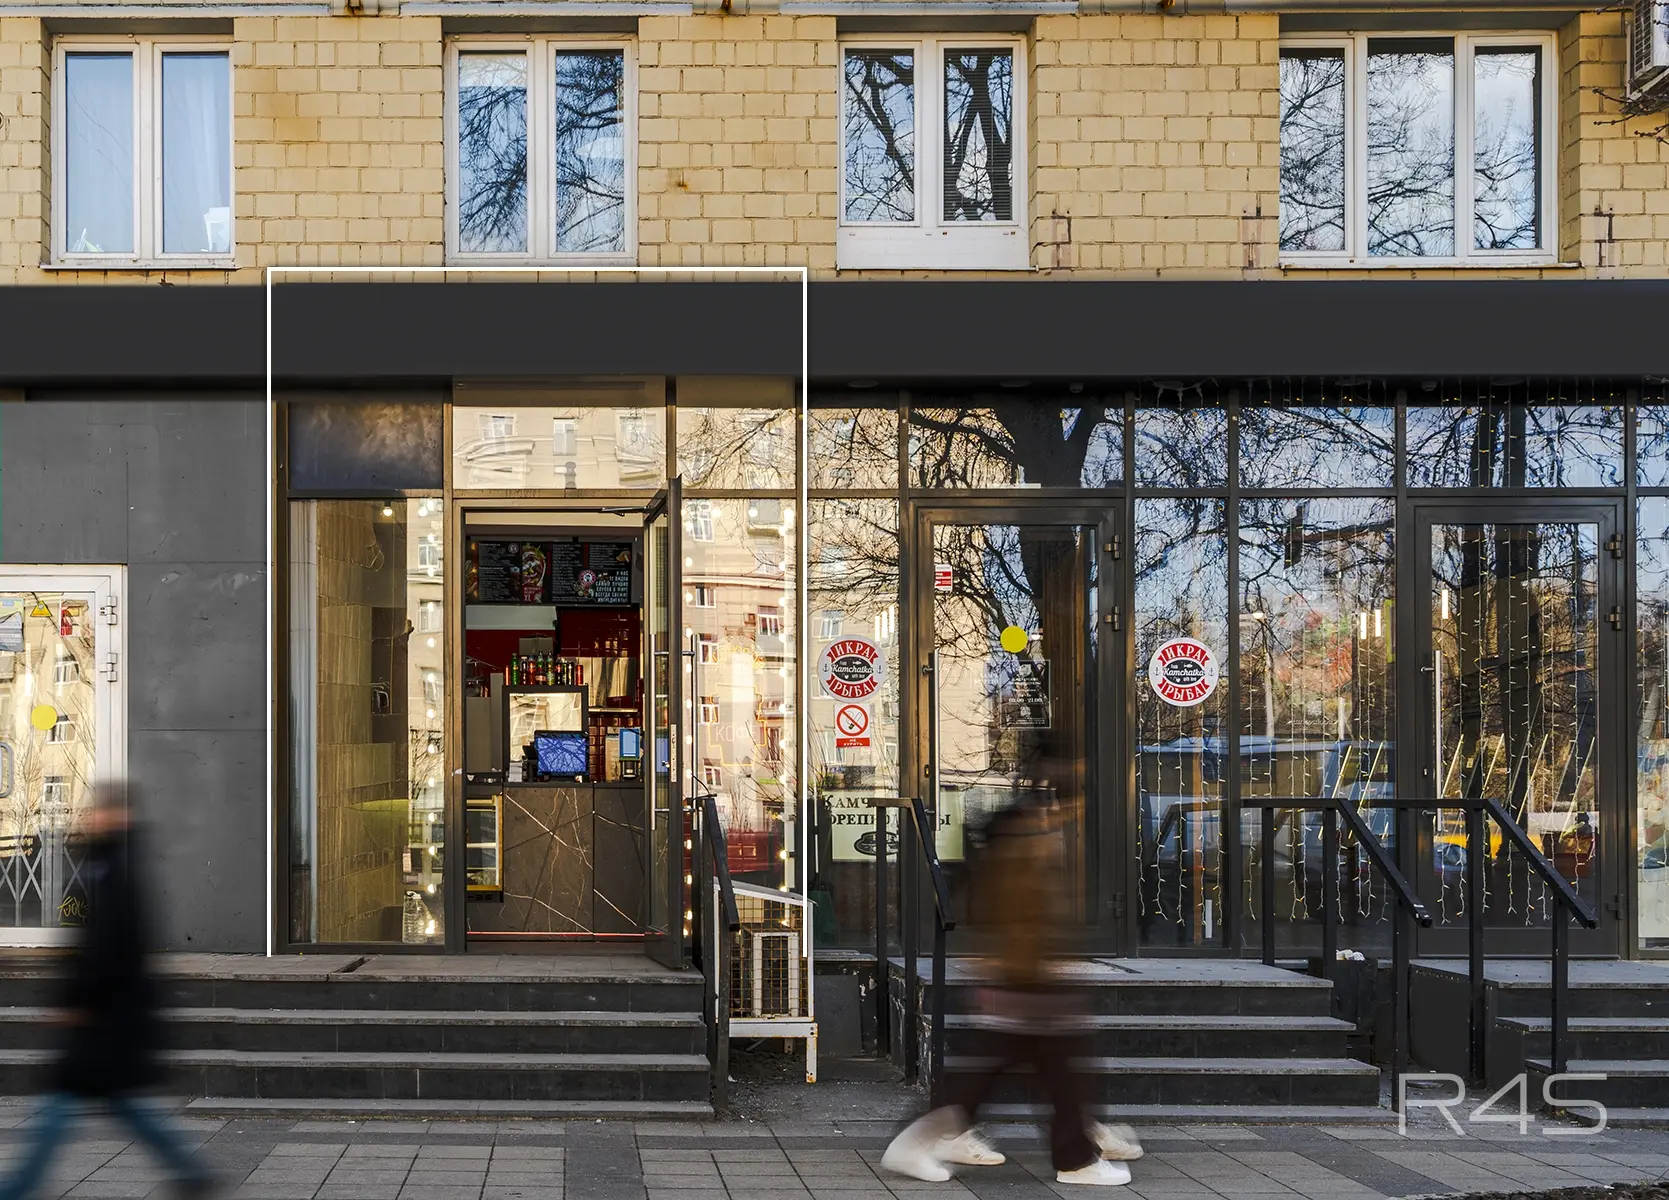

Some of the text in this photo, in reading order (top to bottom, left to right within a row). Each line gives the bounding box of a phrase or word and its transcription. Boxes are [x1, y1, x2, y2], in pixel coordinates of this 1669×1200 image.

[834, 641, 871, 657] ИКРА
[1164, 645, 1202, 660] ИКРА
[831, 663, 874, 674] Kamchatka
[1163, 667, 1205, 677] Kamchatka
[833, 682, 872, 697] РЫБА
[1163, 684, 1204, 701] РЫБА
